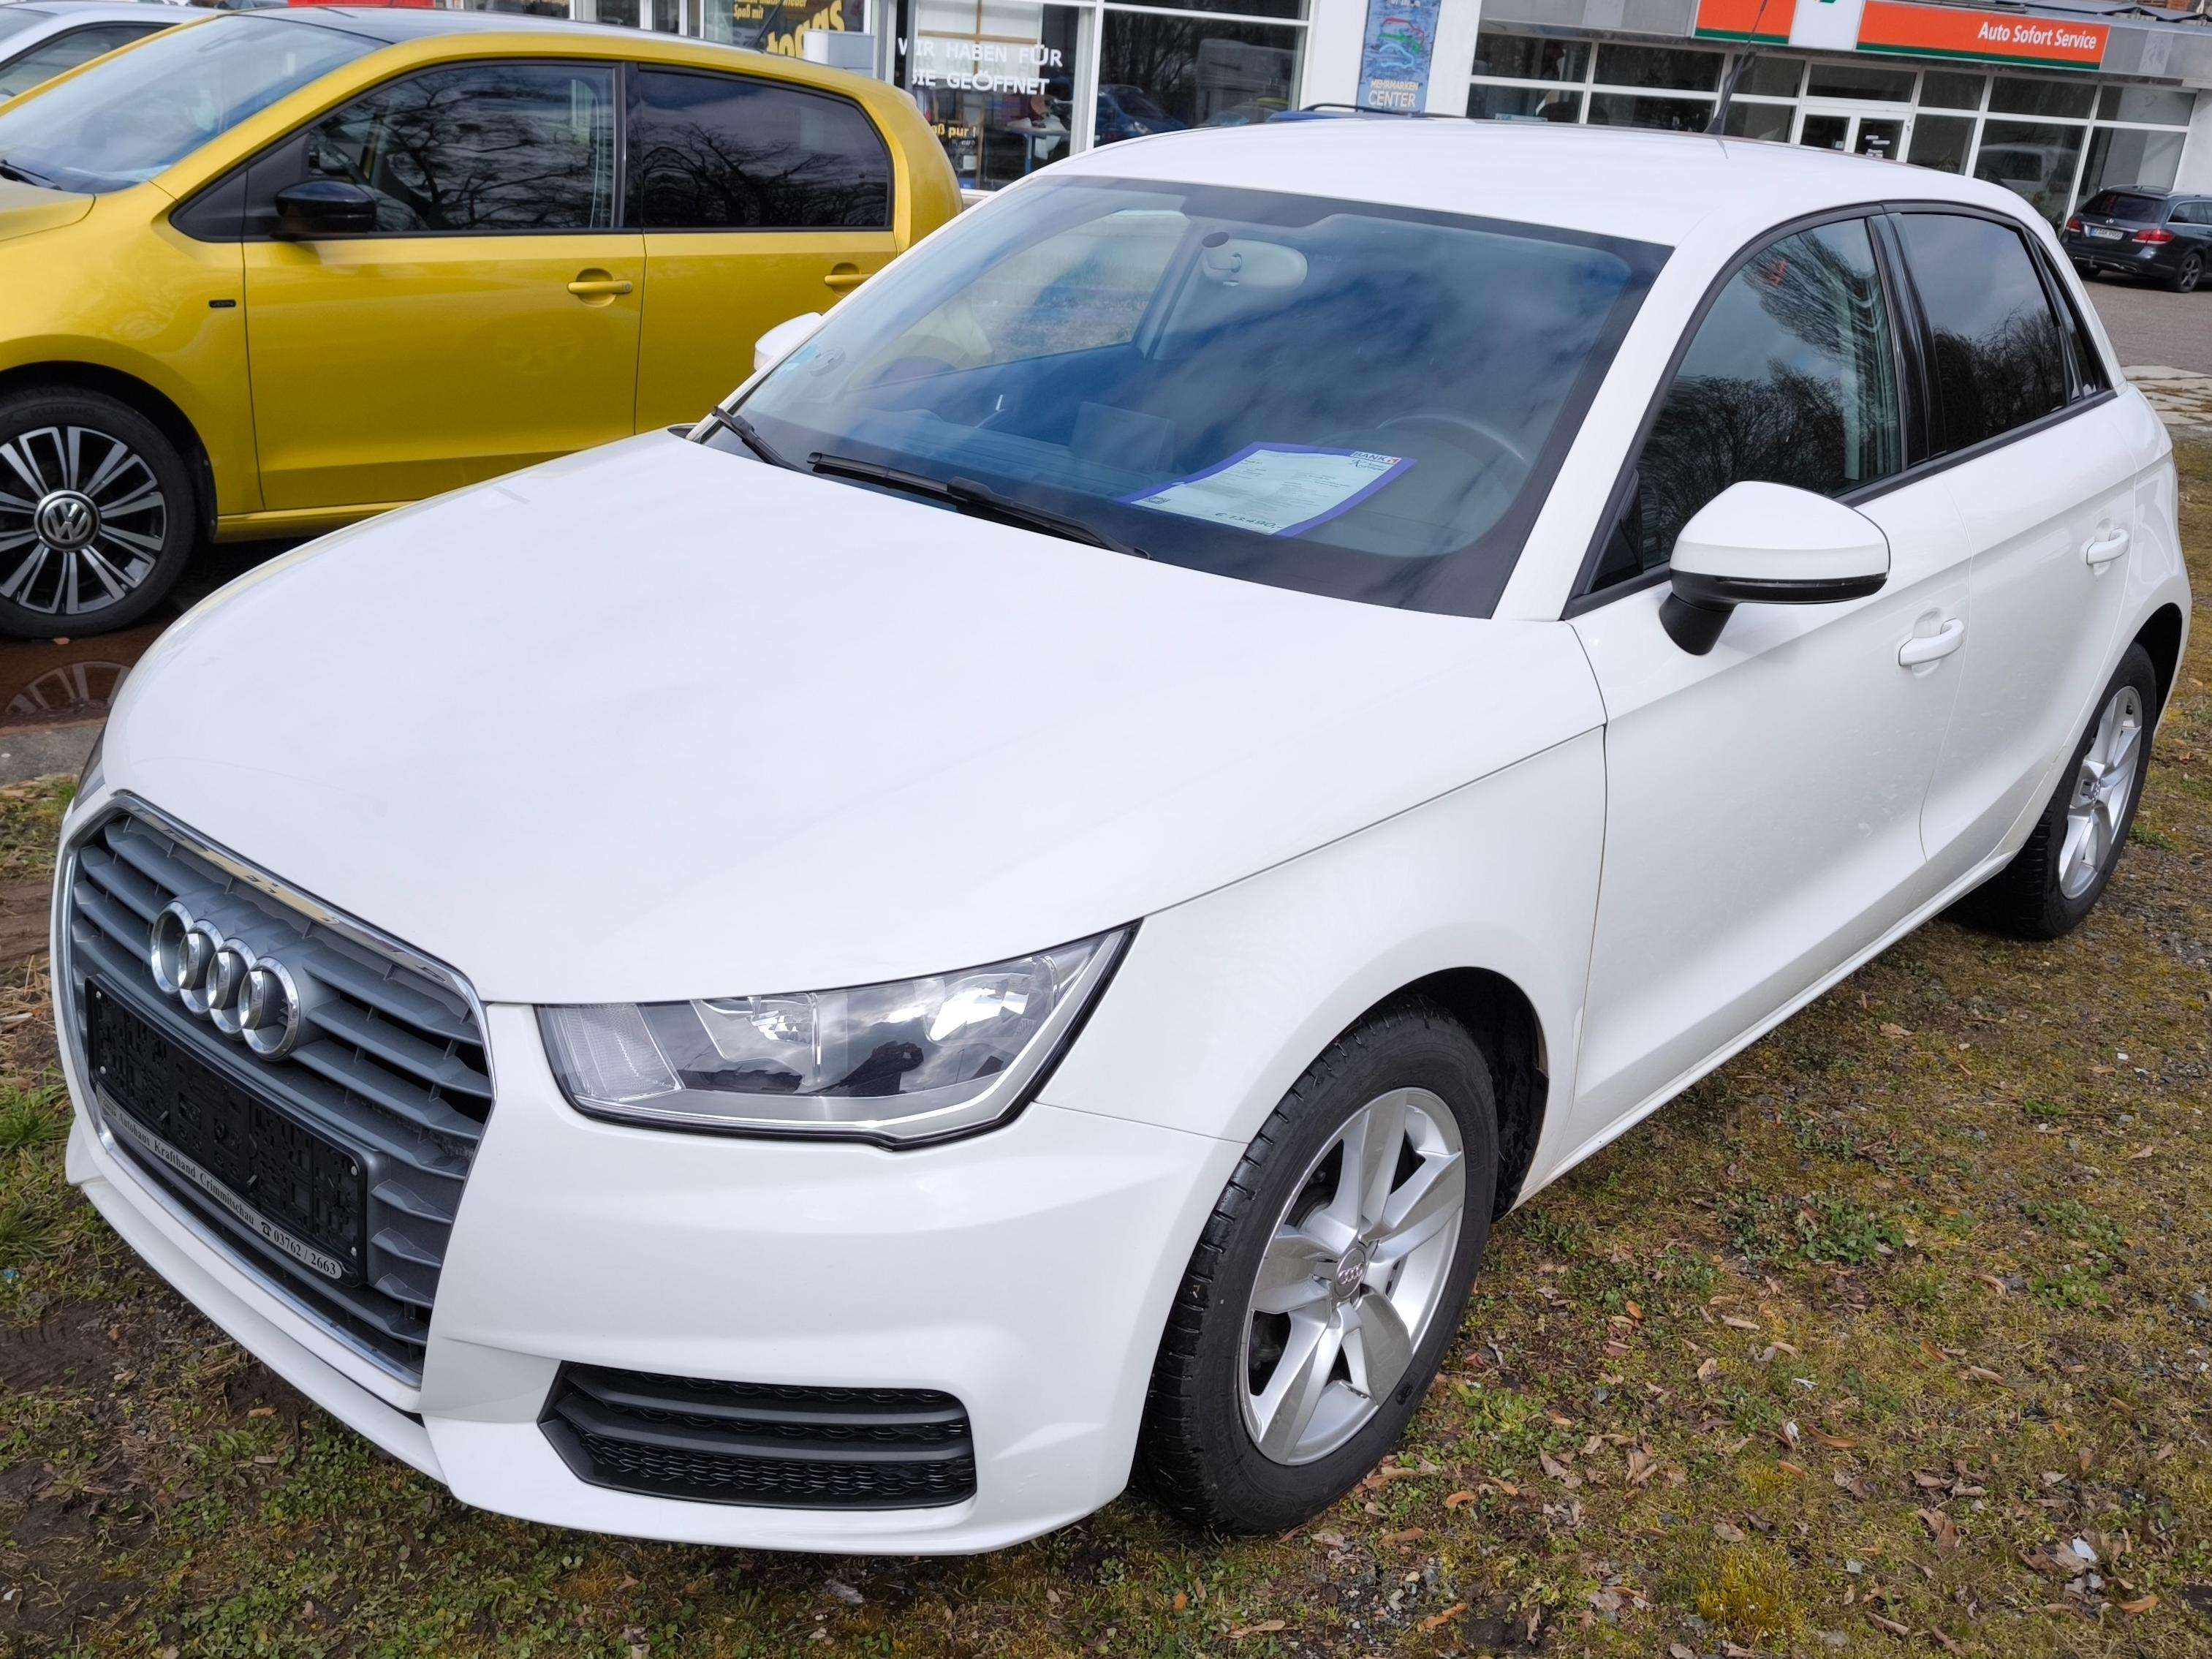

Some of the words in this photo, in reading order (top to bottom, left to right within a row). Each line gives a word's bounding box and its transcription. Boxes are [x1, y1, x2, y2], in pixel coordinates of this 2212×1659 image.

[734, 4, 751, 20] Spaß
[751, 7, 765, 20] mit
[1977, 21, 2011, 42] Auto
[2012, 25, 2053, 46] Sofort
[2054, 29, 2097, 49] Service
[898, 37, 935, 58] WIR
[946, 42, 1007, 63] HABEN
[1019, 44, 1063, 67] FÜR
[947, 70, 1050, 95] GEÖFFNET
[1368, 90, 1416, 107] CENTER
[948, 126, 969, 138] pur
[118, 1111, 150, 1146] Autohaus
[154, 1140, 196, 1178] Krafthand
[200, 1173, 254, 1225] Crimmitschau
[273, 1230, 301, 1257] 03762
[311, 1252, 336, 1275] 2663
